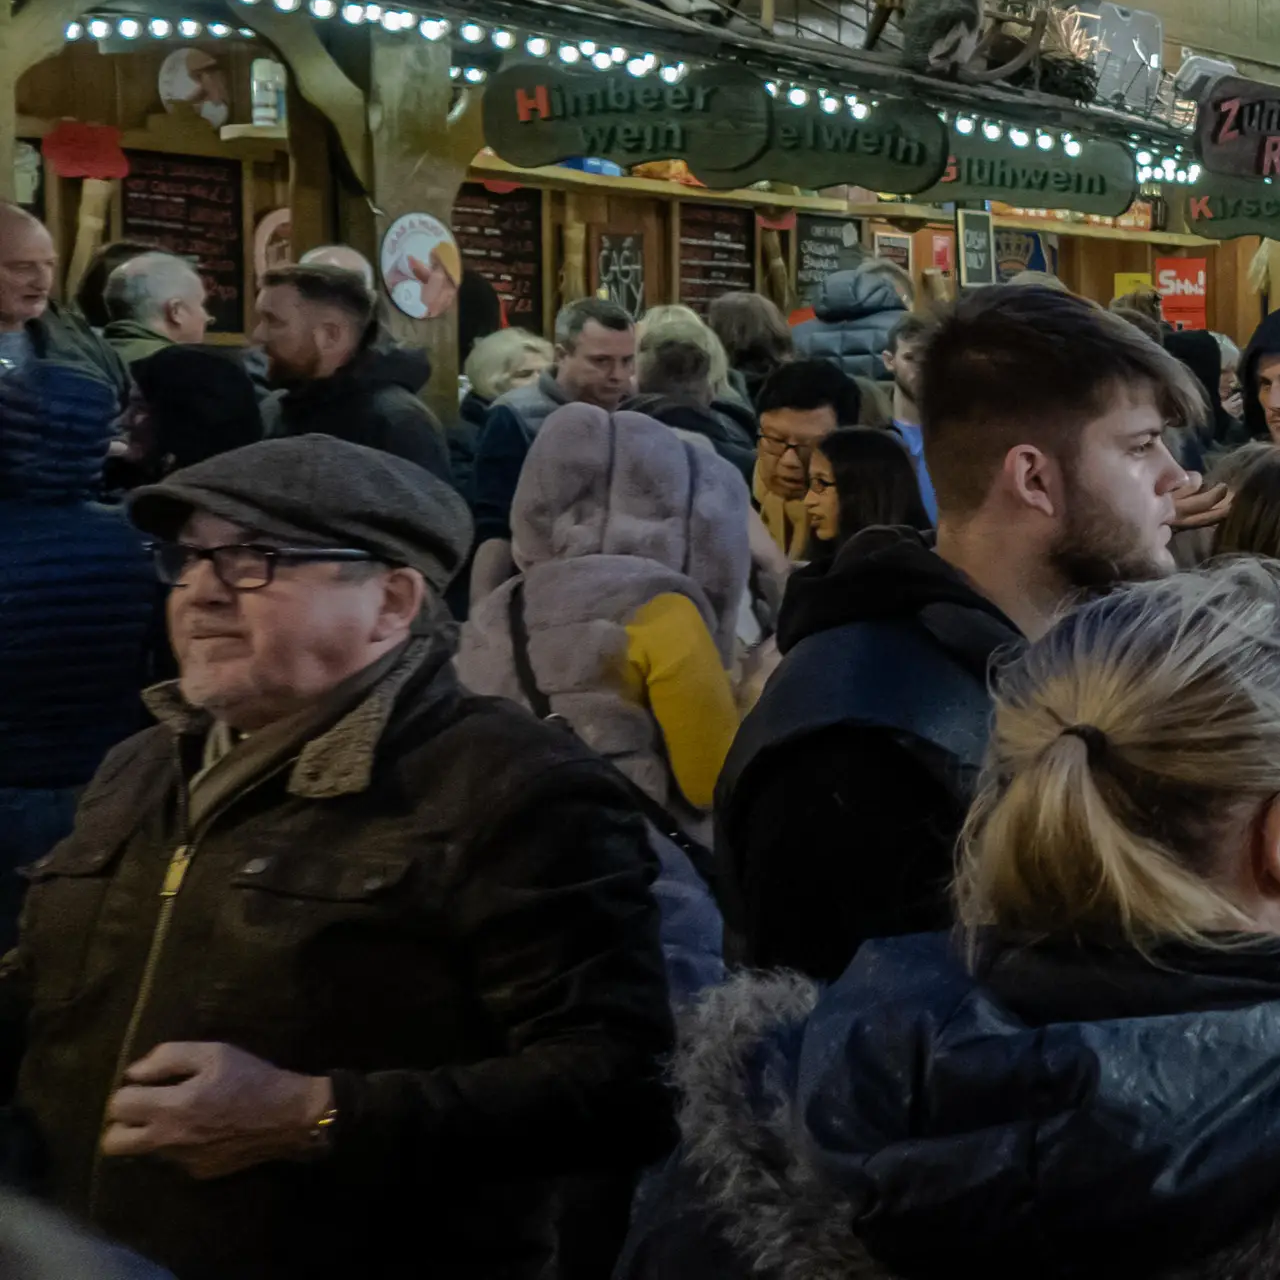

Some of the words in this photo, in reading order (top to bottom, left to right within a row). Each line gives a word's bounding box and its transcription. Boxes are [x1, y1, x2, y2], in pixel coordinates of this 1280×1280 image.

[515, 77, 716, 122] Himbeer
[579, 121, 686, 154] wein
[778, 117, 927, 166] elwein
